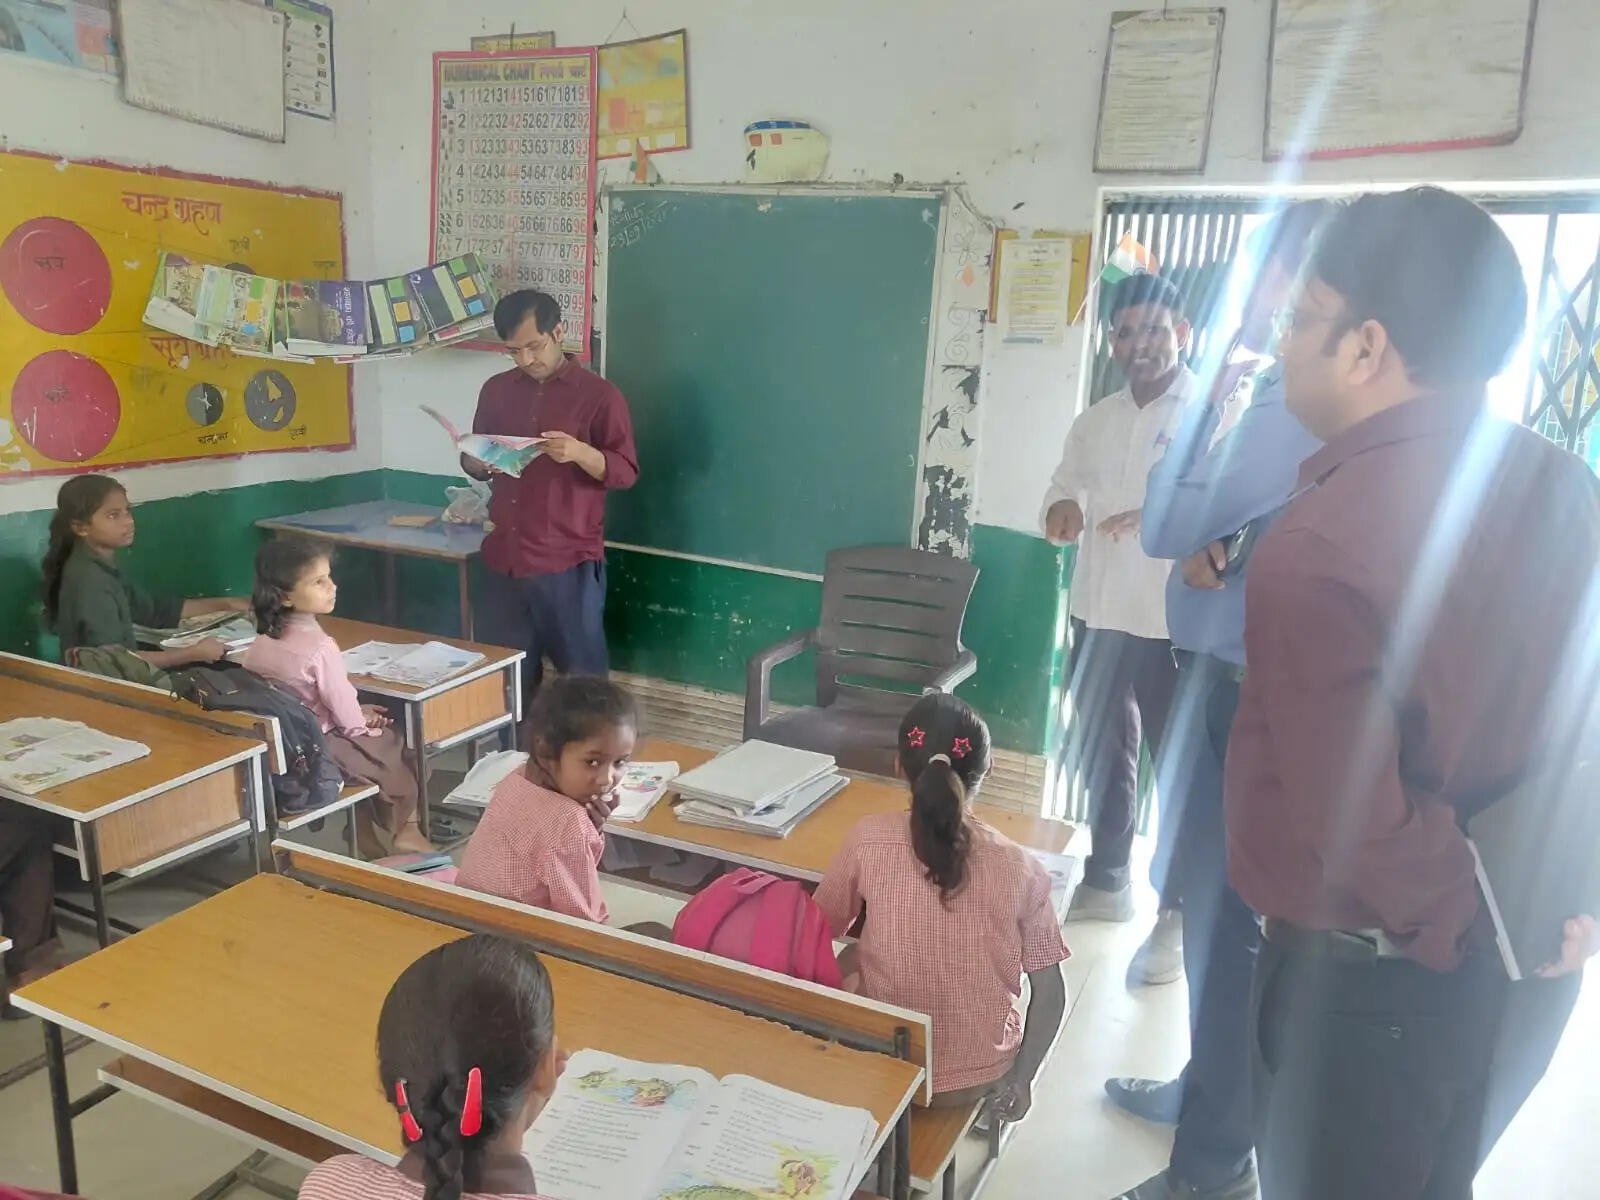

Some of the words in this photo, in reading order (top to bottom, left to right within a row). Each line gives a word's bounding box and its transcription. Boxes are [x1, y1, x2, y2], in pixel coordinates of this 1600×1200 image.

[460, 88, 465, 103] 1
[484, 88, 495, 103] 21
[497, 88, 508, 102] 31
[524, 88, 534, 102] 51
[538, 88, 548, 102] 61
[552, 87, 562, 102] 71
[564, 87, 576, 102] 81
[458, 114, 466, 128] 2
[482, 114, 494, 128] 22
[496, 114, 508, 128] 32
[522, 114, 534, 128] 52
[536, 114, 548, 128] 62
[564, 113, 576, 128] 82
[482, 139, 493, 154] 23
[522, 139, 534, 154] 53
[535, 139, 548, 154] 63
[562, 139, 574, 154] 83
[456, 164, 464, 178] 4
[494, 165, 505, 178] 34
[520, 166, 532, 179] 54
[534, 166, 546, 179] 64
[561, 166, 572, 180] 84
[456, 190, 464, 203] 5
[493, 190, 505, 204] 35
[520, 191, 532, 206] 55
[534, 191, 546, 206] 65
[560, 192, 572, 206] 85
[574, 192, 586, 206] 95
[121, 190, 170, 222] चन्द्र
[173, 196, 224, 236] ग्रहण
[456, 213, 464, 226] 6
[479, 214, 491, 228] 26
[520, 216, 532, 231] 56
[533, 216, 545, 231] 66
[560, 217, 572, 232] 86
[574, 217, 586, 232] 96
[456, 237, 462, 250] 7
[518, 242, 530, 256] 57
[532, 243, 544, 257] 67
[560, 244, 571, 258] 87
[573, 244, 586, 259] 97
[531, 267, 544, 282] 68
[559, 269, 570, 283] 88
[572, 269, 584, 284] 98
